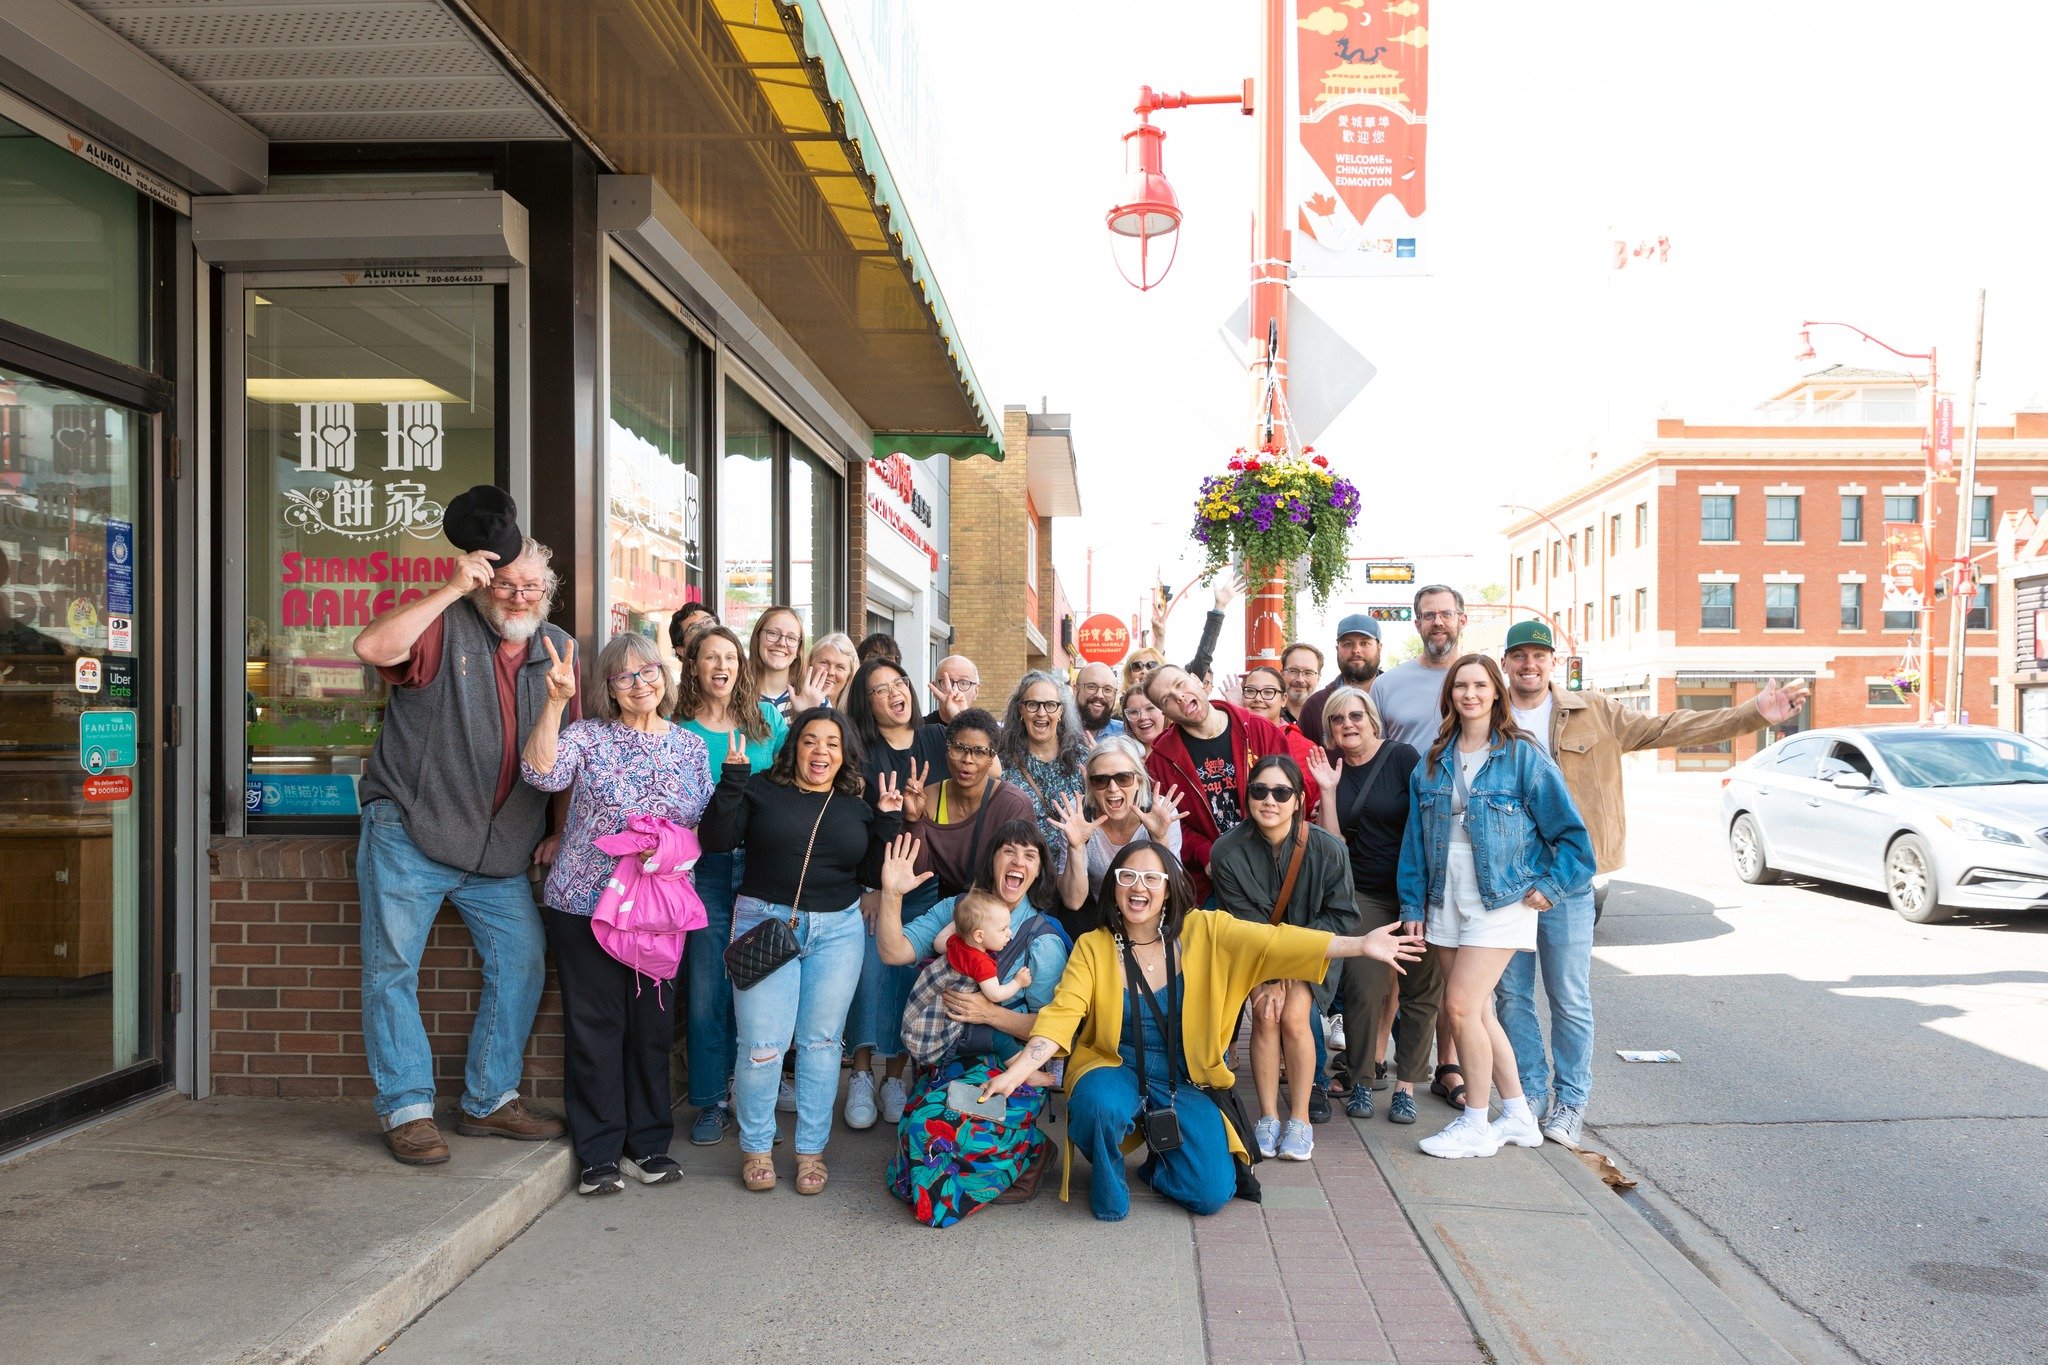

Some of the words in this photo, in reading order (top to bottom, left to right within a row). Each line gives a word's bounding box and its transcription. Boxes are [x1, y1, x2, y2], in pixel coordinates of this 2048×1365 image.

[1338, 115, 1390, 128] 愛城華埠
[1343, 130, 1385, 144] 歡迎您
[86, 143, 132, 176] ALUROLL
[1335, 153, 1385, 164] WELCOME
[1335, 165, 1392, 175] CHINATOWN
[1335, 176, 1392, 187] EDMONTON
[364, 269, 420, 278] ALUROLL
[426, 275, 483, 283] 780-604-6633
[1940, 398, 1950, 445] Chinatown
[282, 588, 441, 627] BAKE
[111, 630, 129, 638] WARNING
[110, 673, 131, 685] Uber
[110, 685, 131, 697] Eats
[85, 723, 132, 732] FANTUAN
[98, 786, 129, 794] DOORDASH
